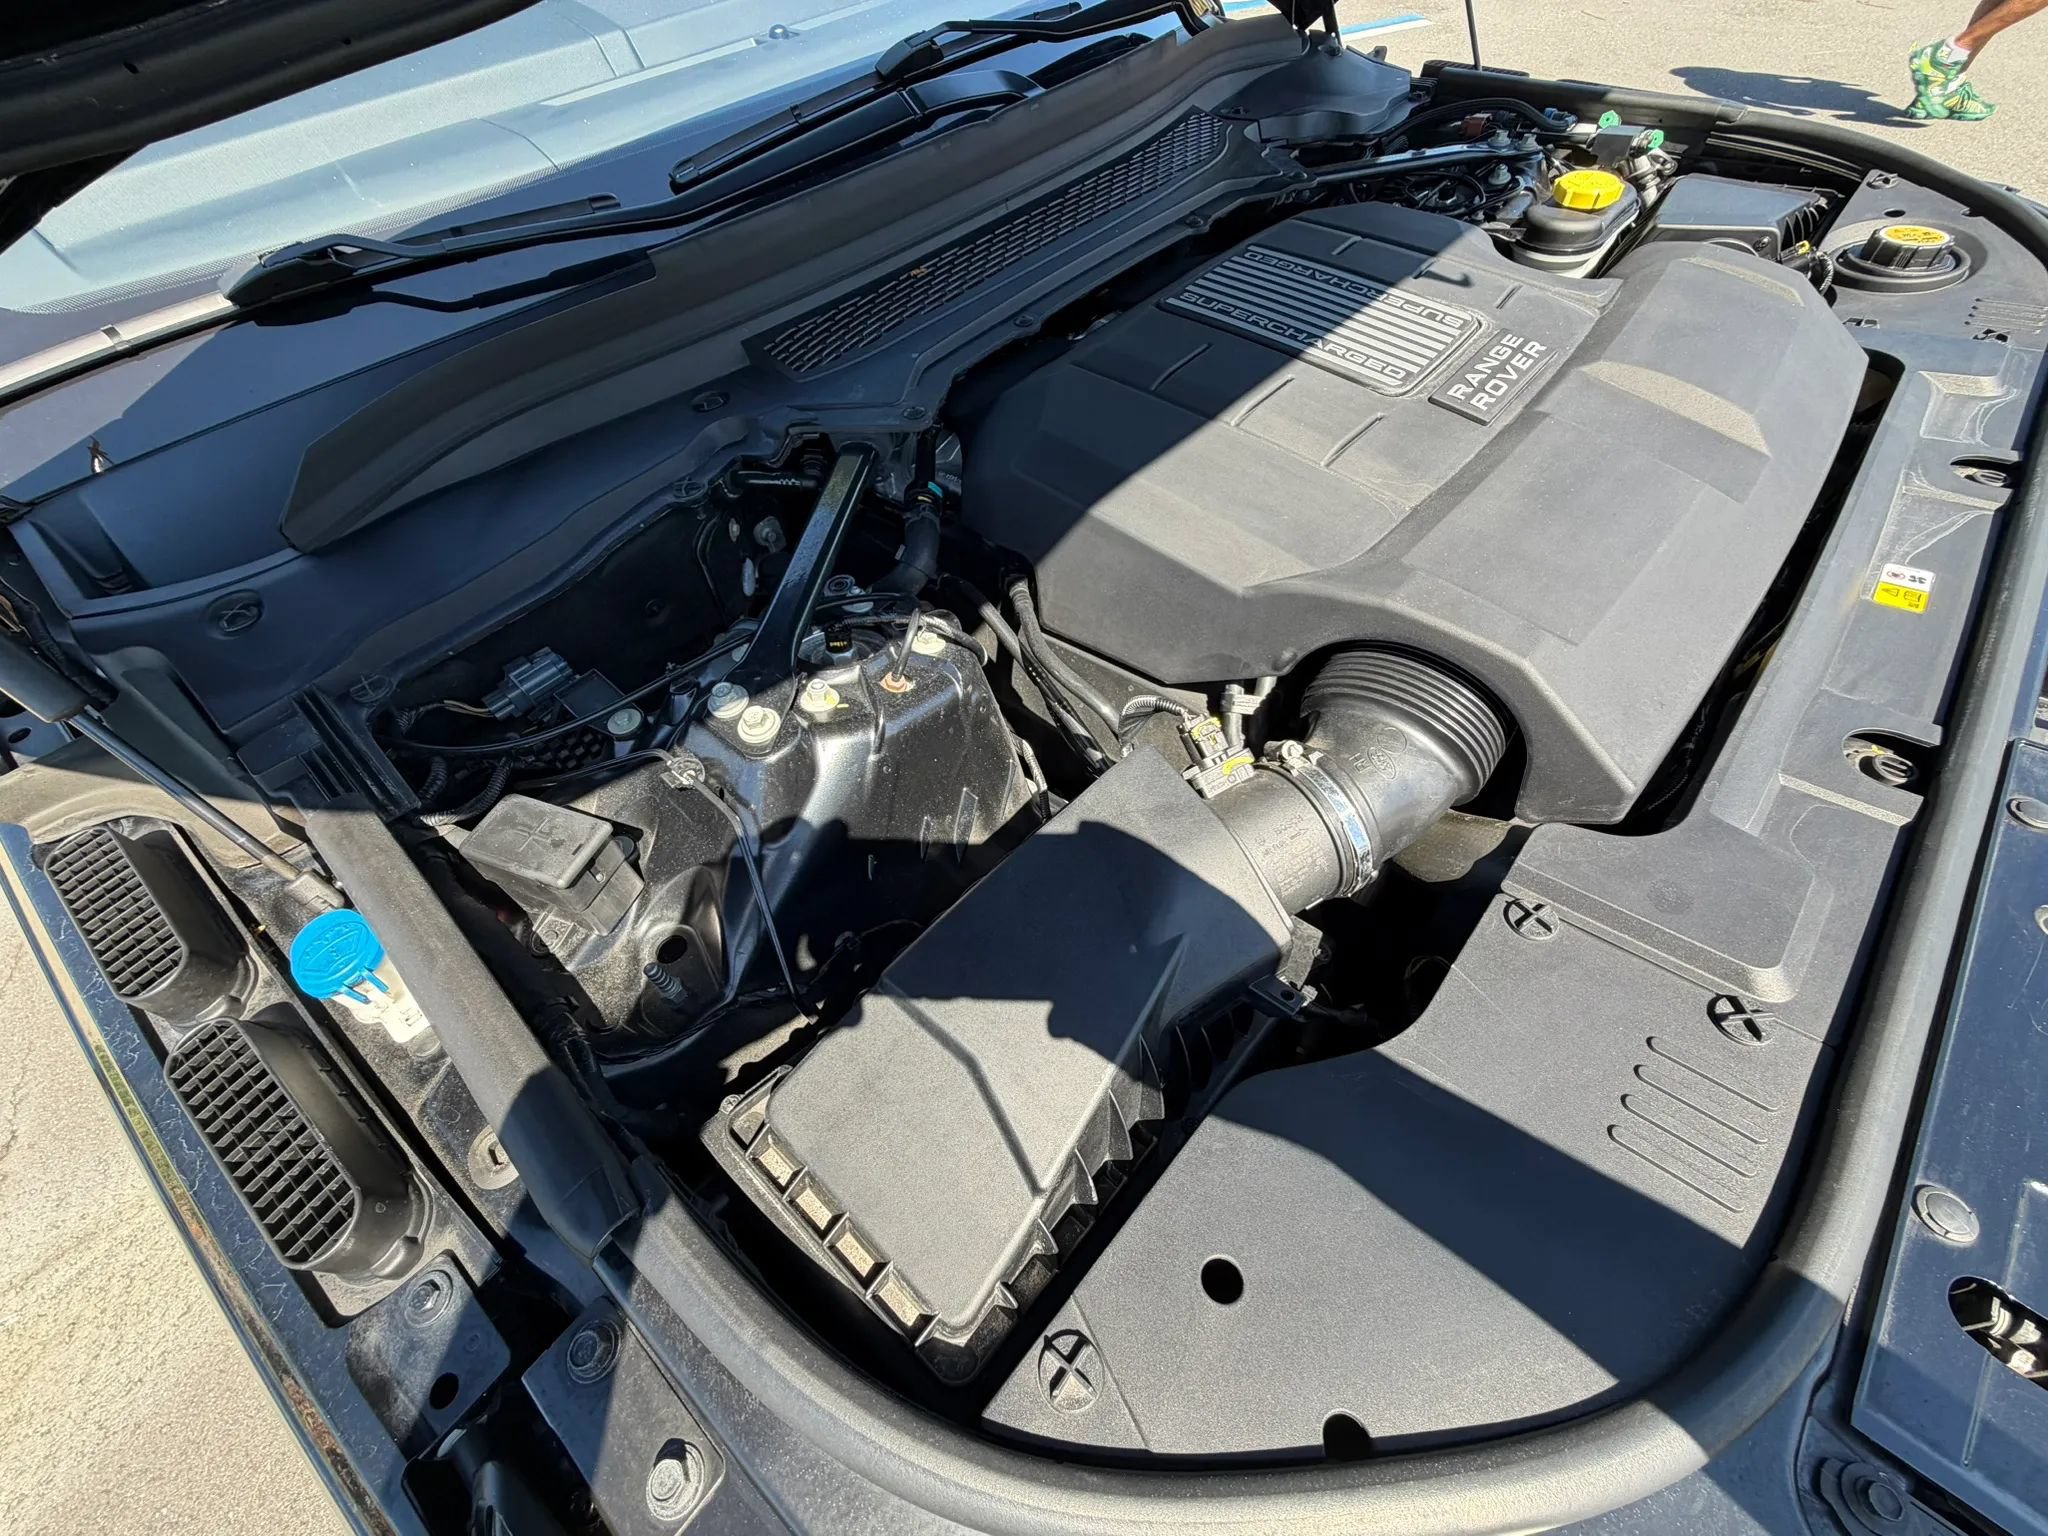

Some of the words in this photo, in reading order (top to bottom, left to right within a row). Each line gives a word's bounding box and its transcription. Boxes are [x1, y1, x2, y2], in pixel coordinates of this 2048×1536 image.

[1244, 251, 1465, 329] SUPERCHARGED
[1179, 292, 1407, 380] SUPERCHARGED
[1446, 334, 1525, 400] RANGE
[1469, 341, 1548, 411] ROVER
